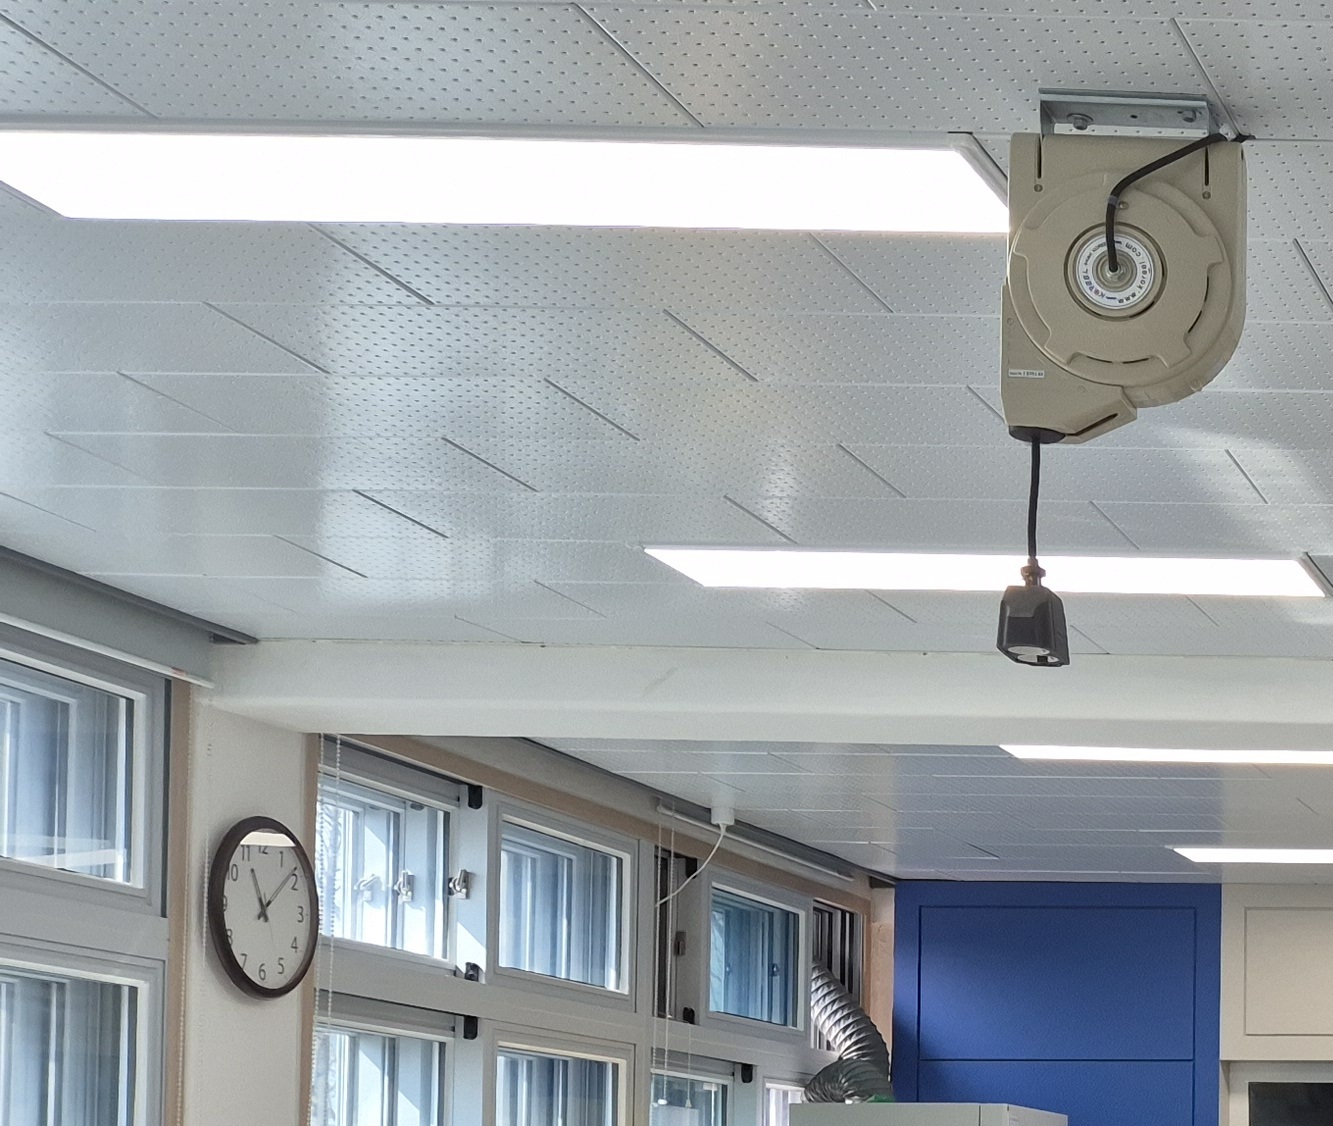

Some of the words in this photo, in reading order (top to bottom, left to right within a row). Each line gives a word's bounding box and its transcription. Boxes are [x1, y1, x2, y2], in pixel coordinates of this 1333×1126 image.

[279, 850, 284, 868] 1
[290, 873, 298, 891] 2
[297, 906, 304, 923] 3
[290, 936, 298, 953] 4
[240, 953, 248, 970] 7
[277, 957, 285, 974] 5
[258, 962, 266, 981] 6
